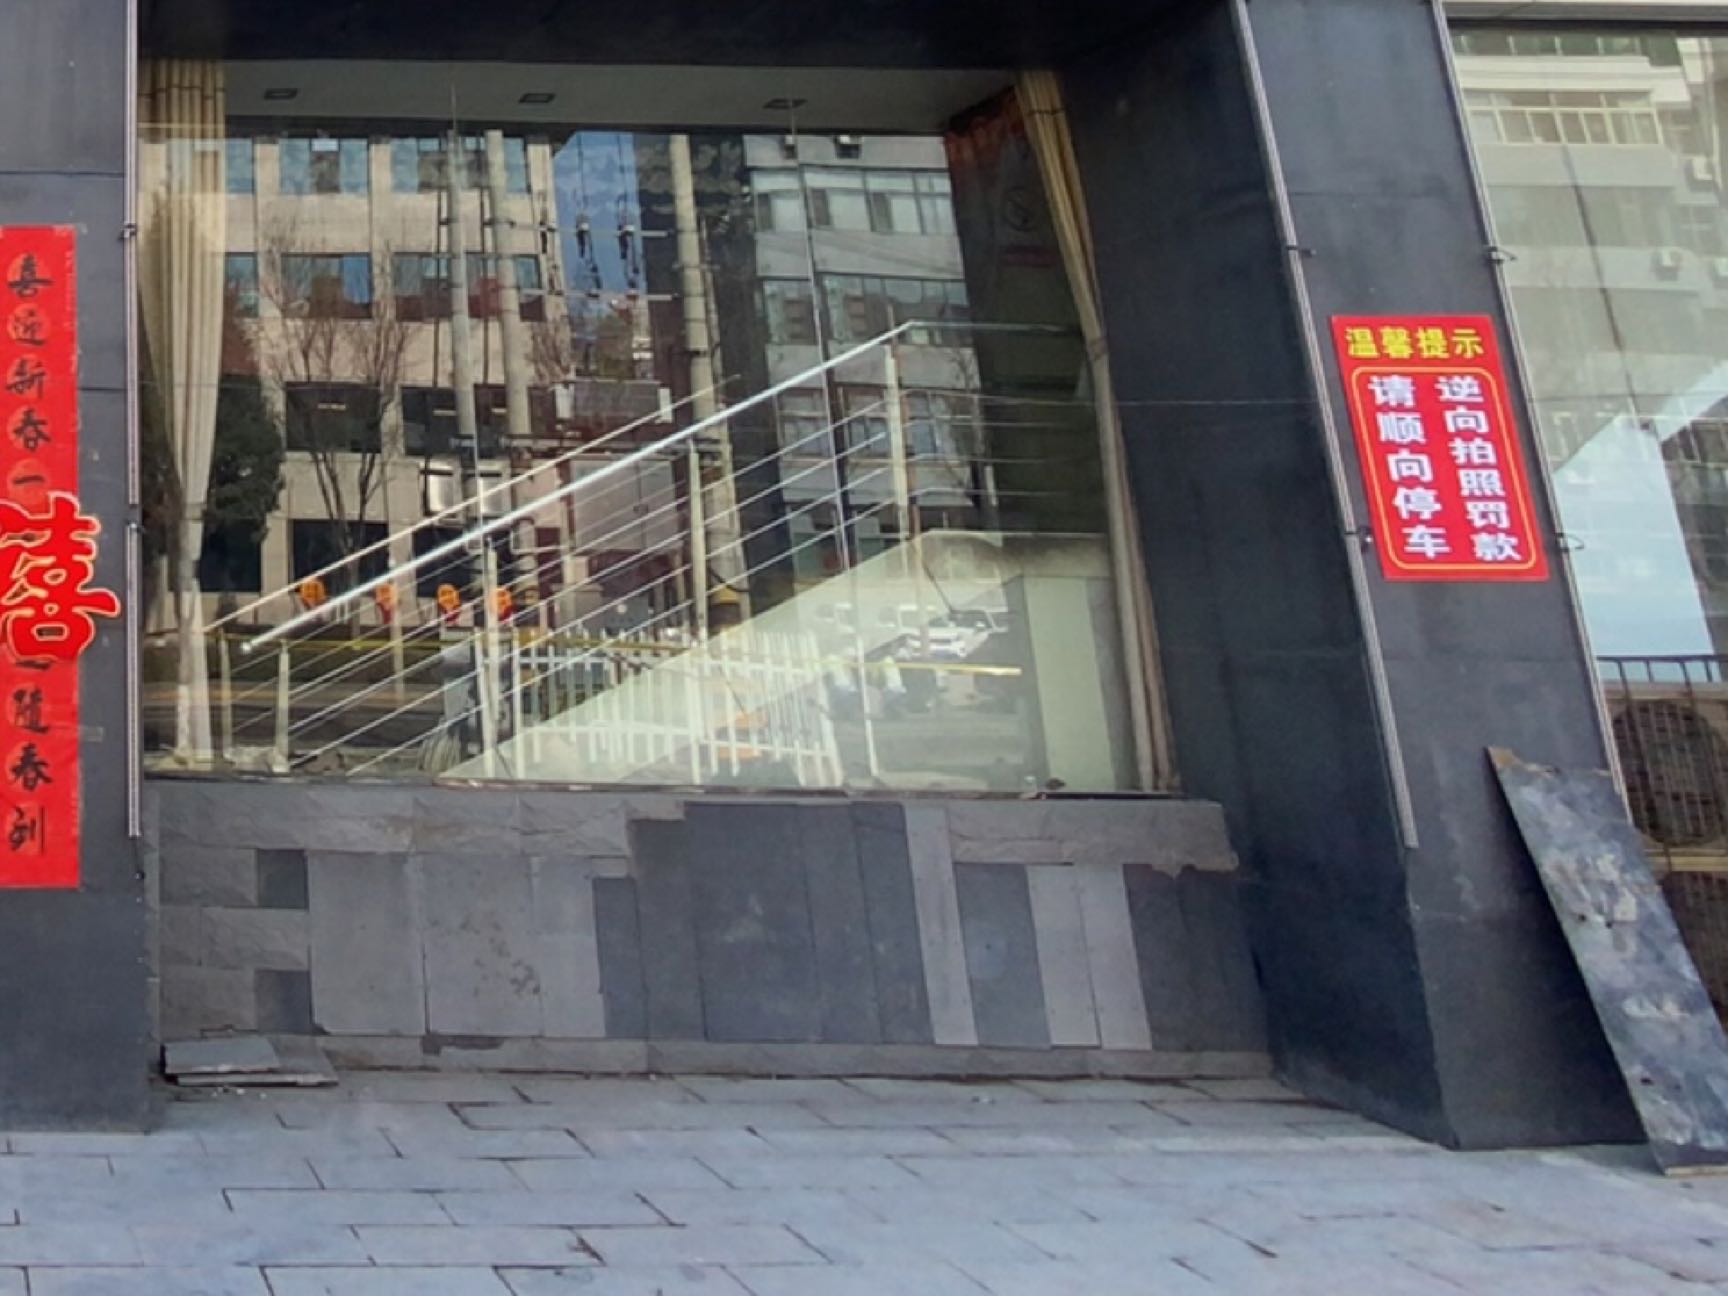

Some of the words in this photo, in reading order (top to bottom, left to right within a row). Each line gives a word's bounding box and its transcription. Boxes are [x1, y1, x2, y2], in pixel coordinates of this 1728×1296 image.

[1345, 325, 1484, 359] 温馨提示
[1368, 374, 1451, 560] 请顺向停车
[1434, 374, 1523, 562] 逆向拍照罚款
